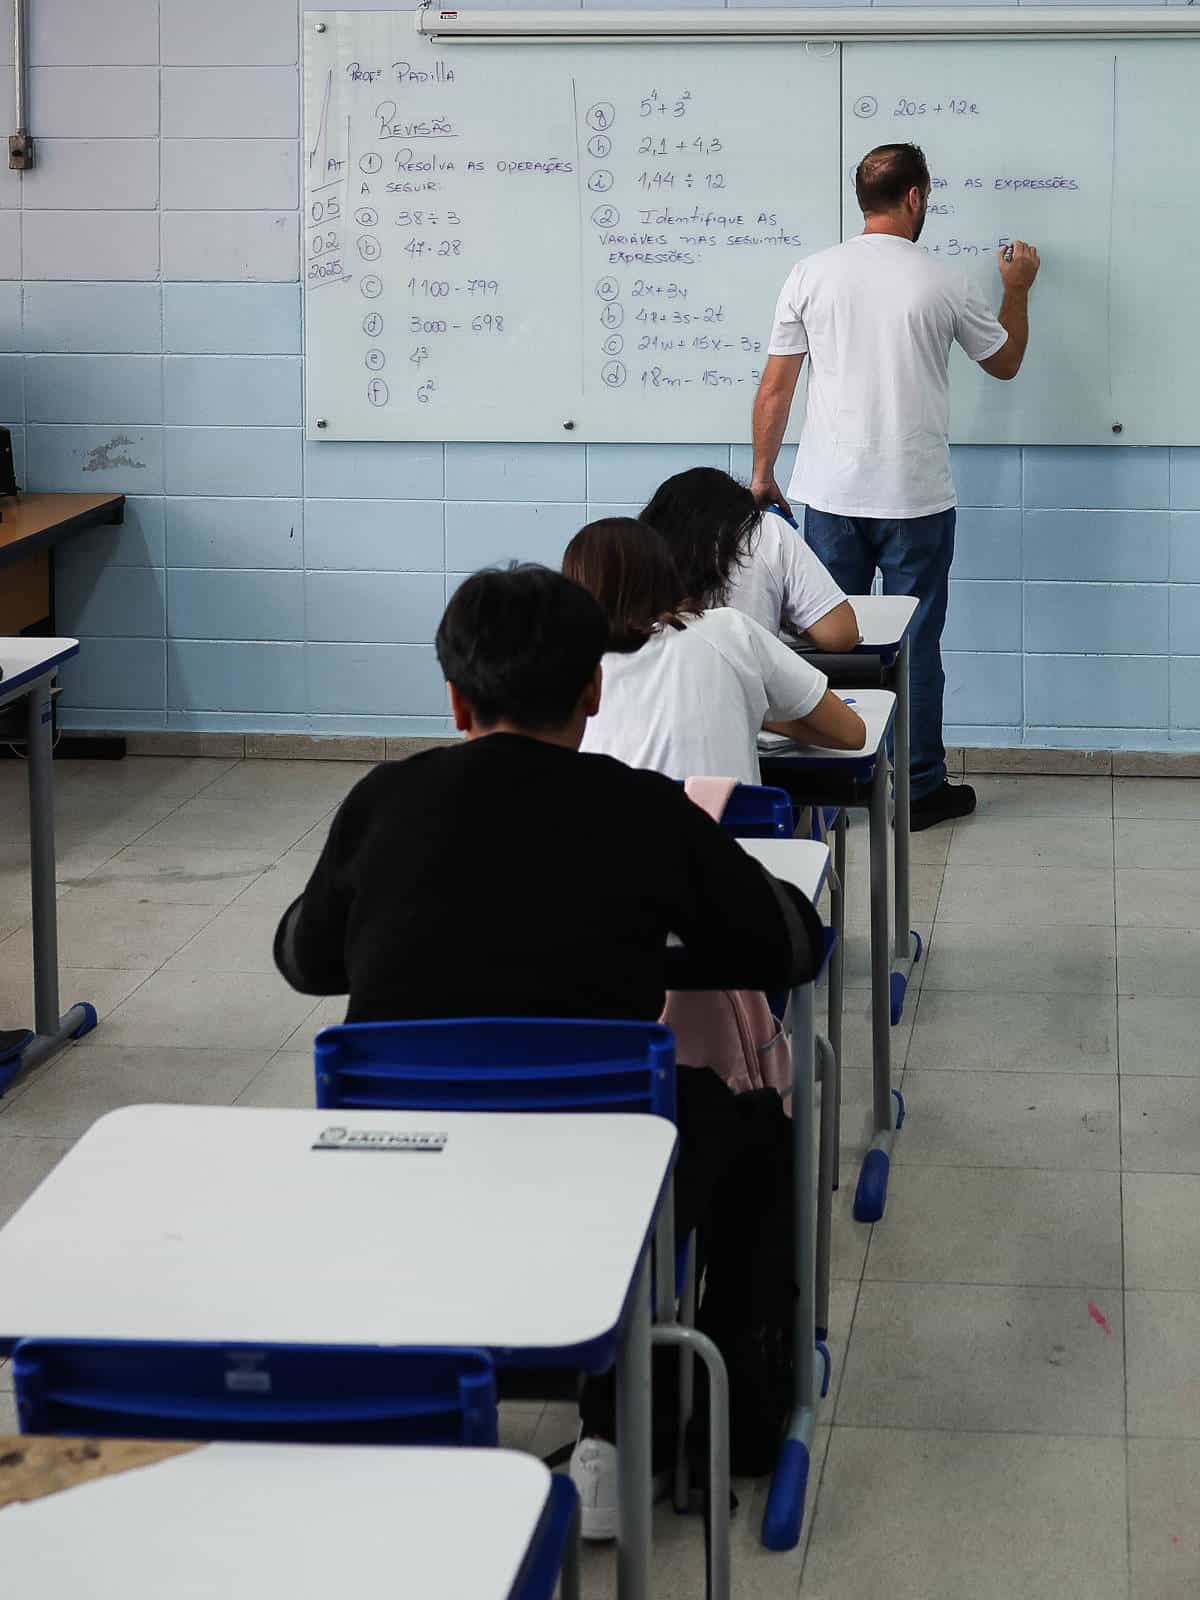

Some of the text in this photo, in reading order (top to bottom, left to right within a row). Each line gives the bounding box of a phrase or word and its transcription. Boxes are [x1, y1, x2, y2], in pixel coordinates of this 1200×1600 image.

[467, 160, 485, 171] AS
[360, 184, 370, 197] A
[964, 176, 1079, 191] AS EXPRESSÕES
[311, 196, 341, 221] 05
[757, 214, 777, 225] AS
[312, 231, 340, 255] 02
[308, 260, 343, 280] 2025
